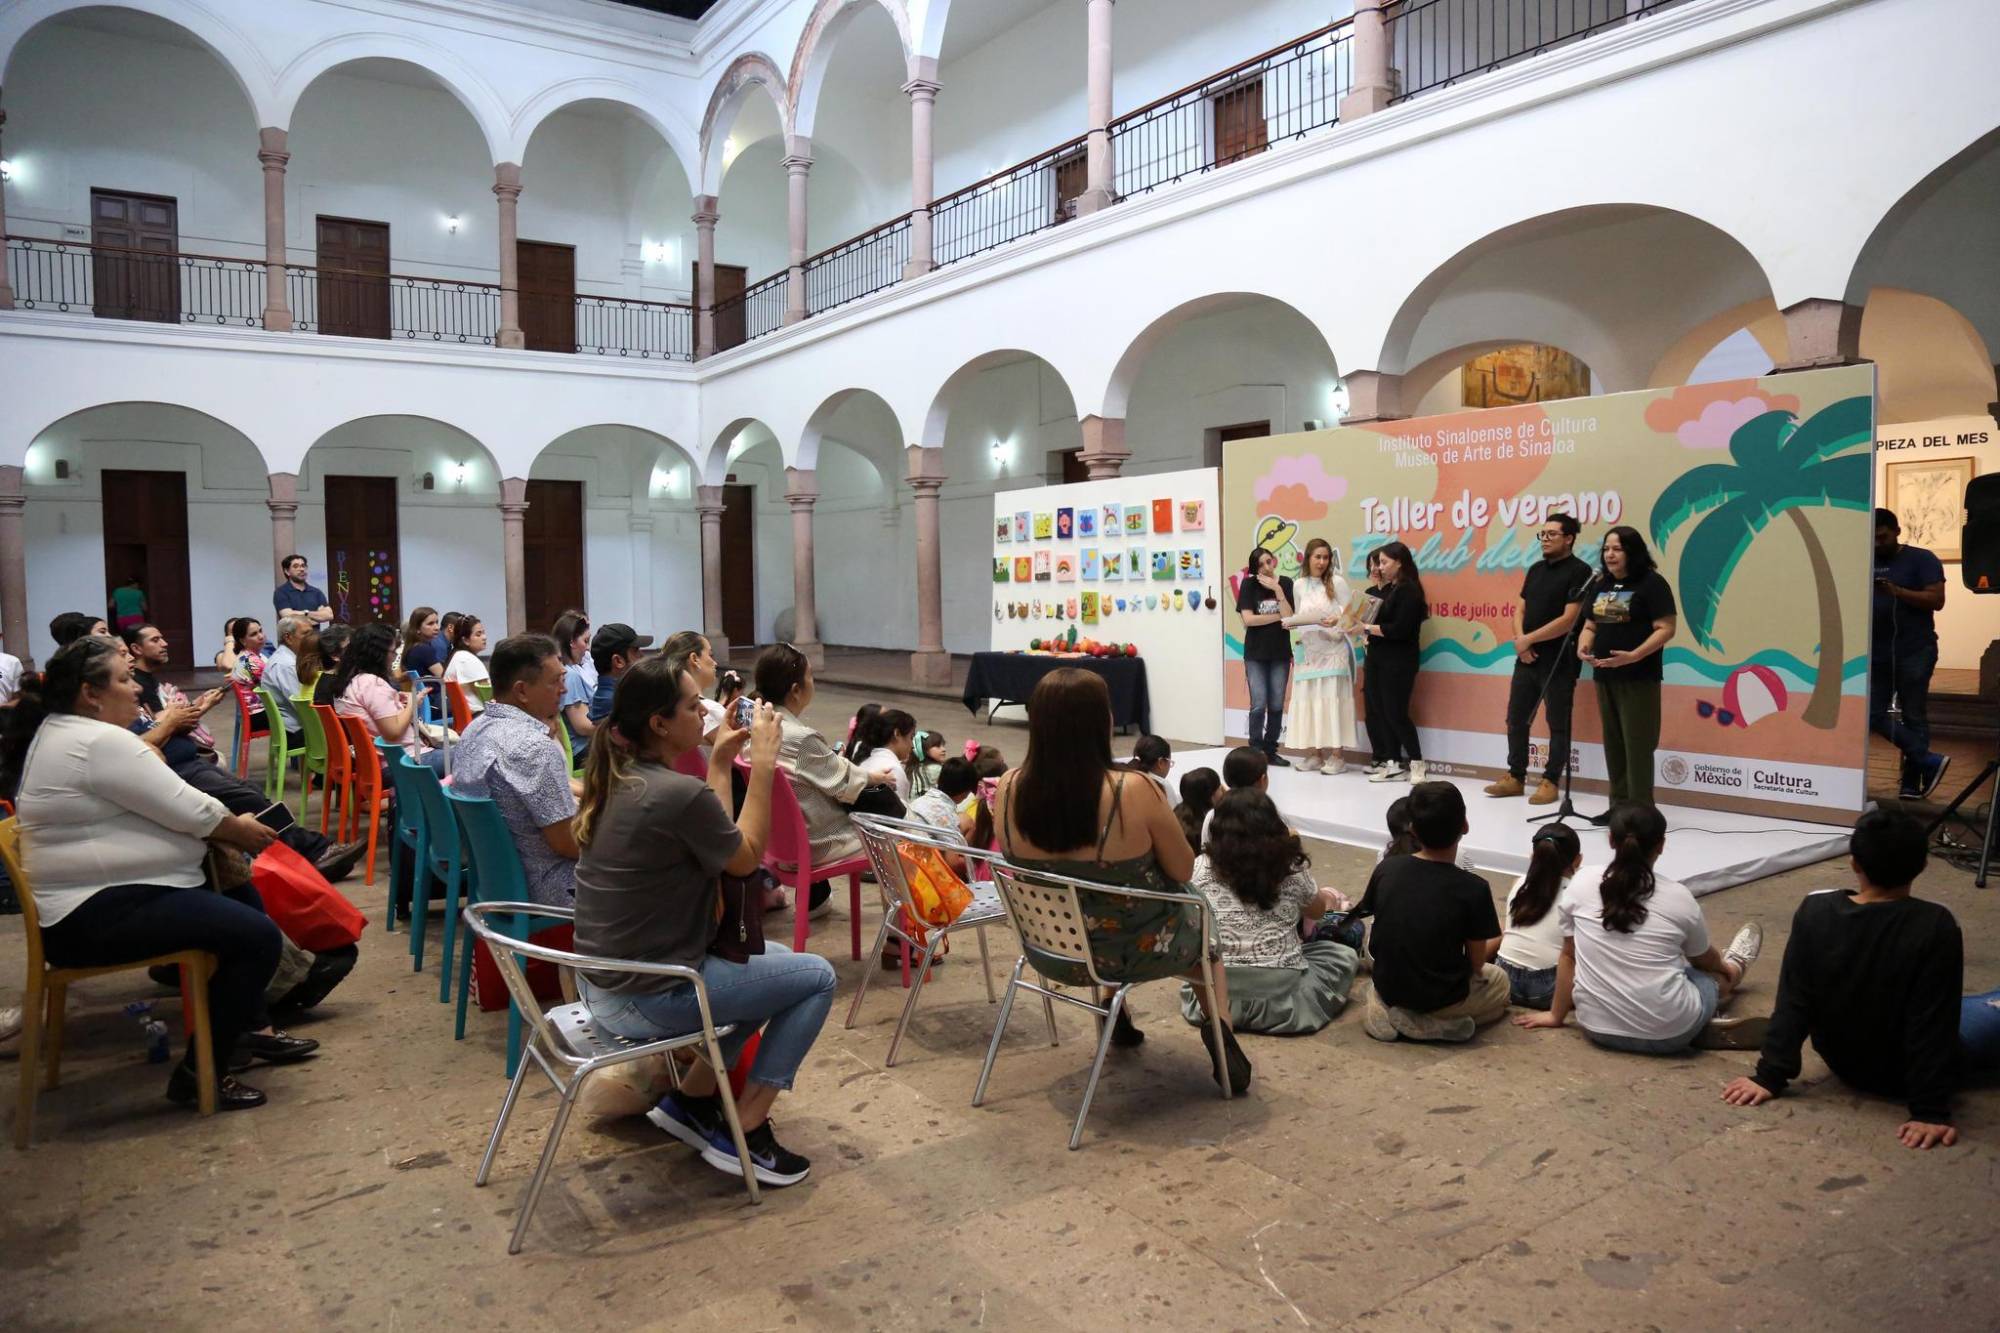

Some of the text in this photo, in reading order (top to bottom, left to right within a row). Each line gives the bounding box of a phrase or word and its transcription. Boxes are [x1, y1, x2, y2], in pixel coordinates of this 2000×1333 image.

[1378, 416, 1598, 452] Instituto Sinaloense de Cultura
[1876, 432, 1989, 451] PIEZA DEL MES
[1395, 436, 1575, 468] Museo de Arte de Sinaloa
[1360, 488, 1622, 533] Taller de verano
[1436, 602, 1449, 618] 18
[1452, 601, 1467, 617] de
[1468, 602, 1498, 622] julio
[1501, 602, 1516, 618] de
[1694, 764, 1730, 774] Gobierno
[1694, 770, 1742, 787] México
[1753, 770, 1812, 789] Cultura
